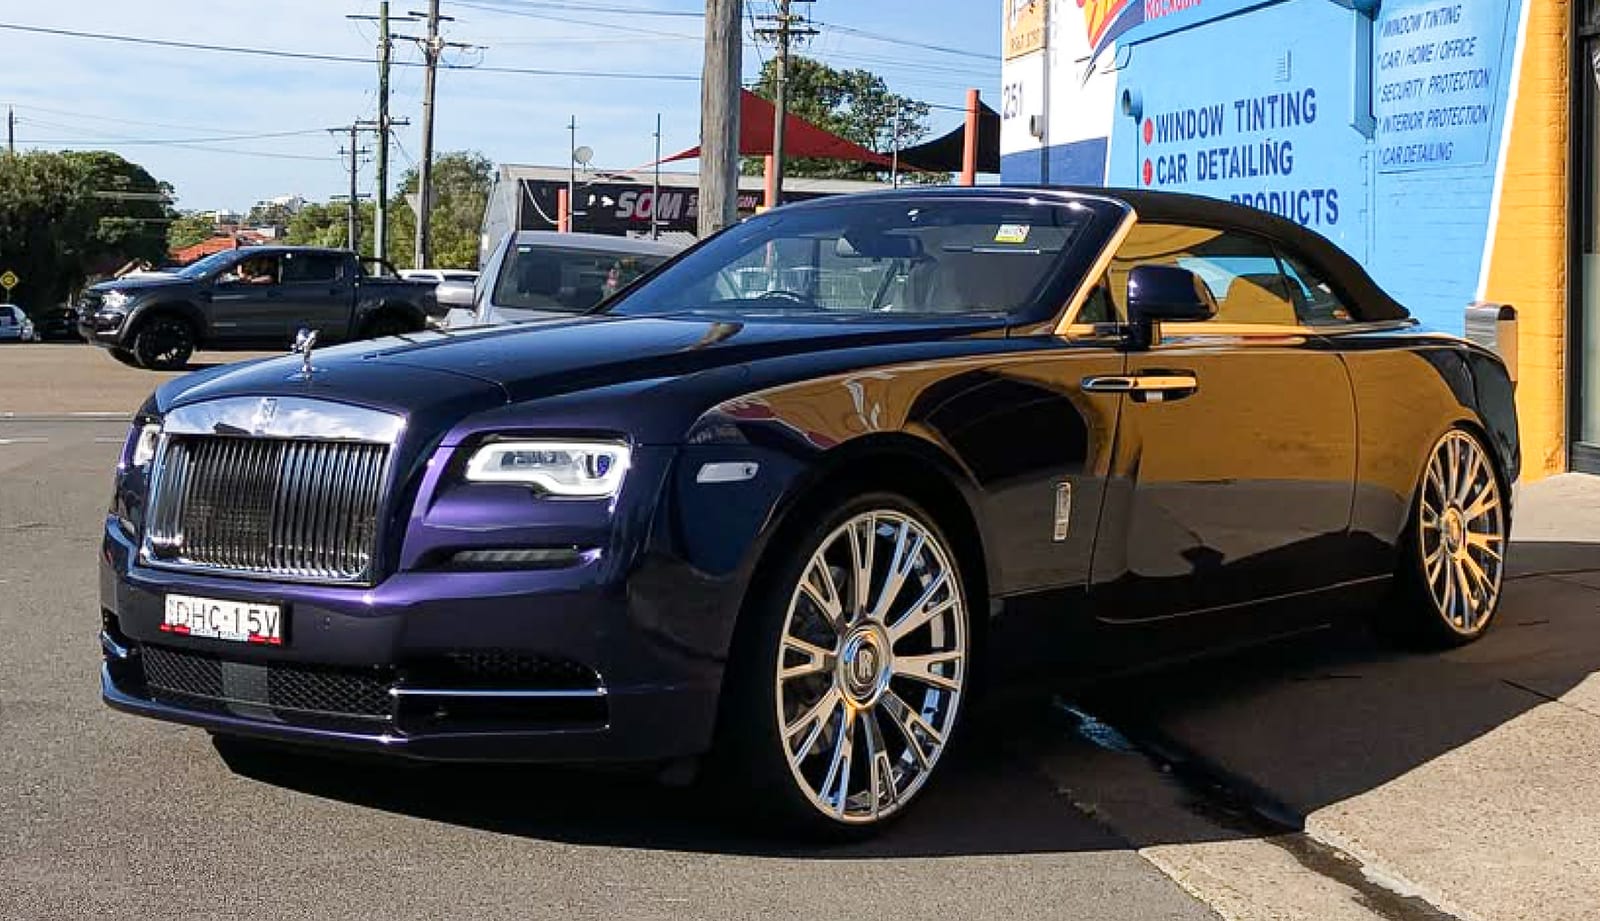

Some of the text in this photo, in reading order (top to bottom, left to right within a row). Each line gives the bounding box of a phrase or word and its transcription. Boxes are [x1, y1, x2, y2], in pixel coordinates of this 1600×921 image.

[1383, 5, 1461, 37] WINDOW TINTING
[1440, 36, 1477, 60] OFFICE
[1004, 80, 1023, 120] 251
[1381, 68, 1489, 102] SECURITY PROTECTION
[1156, 88, 1316, 143] WINDOW TINTING
[1382, 104, 1488, 133] INTERIOR PROTECTION
[1157, 140, 1293, 184] CAR DETAILING
[615, 191, 683, 219] SOM
